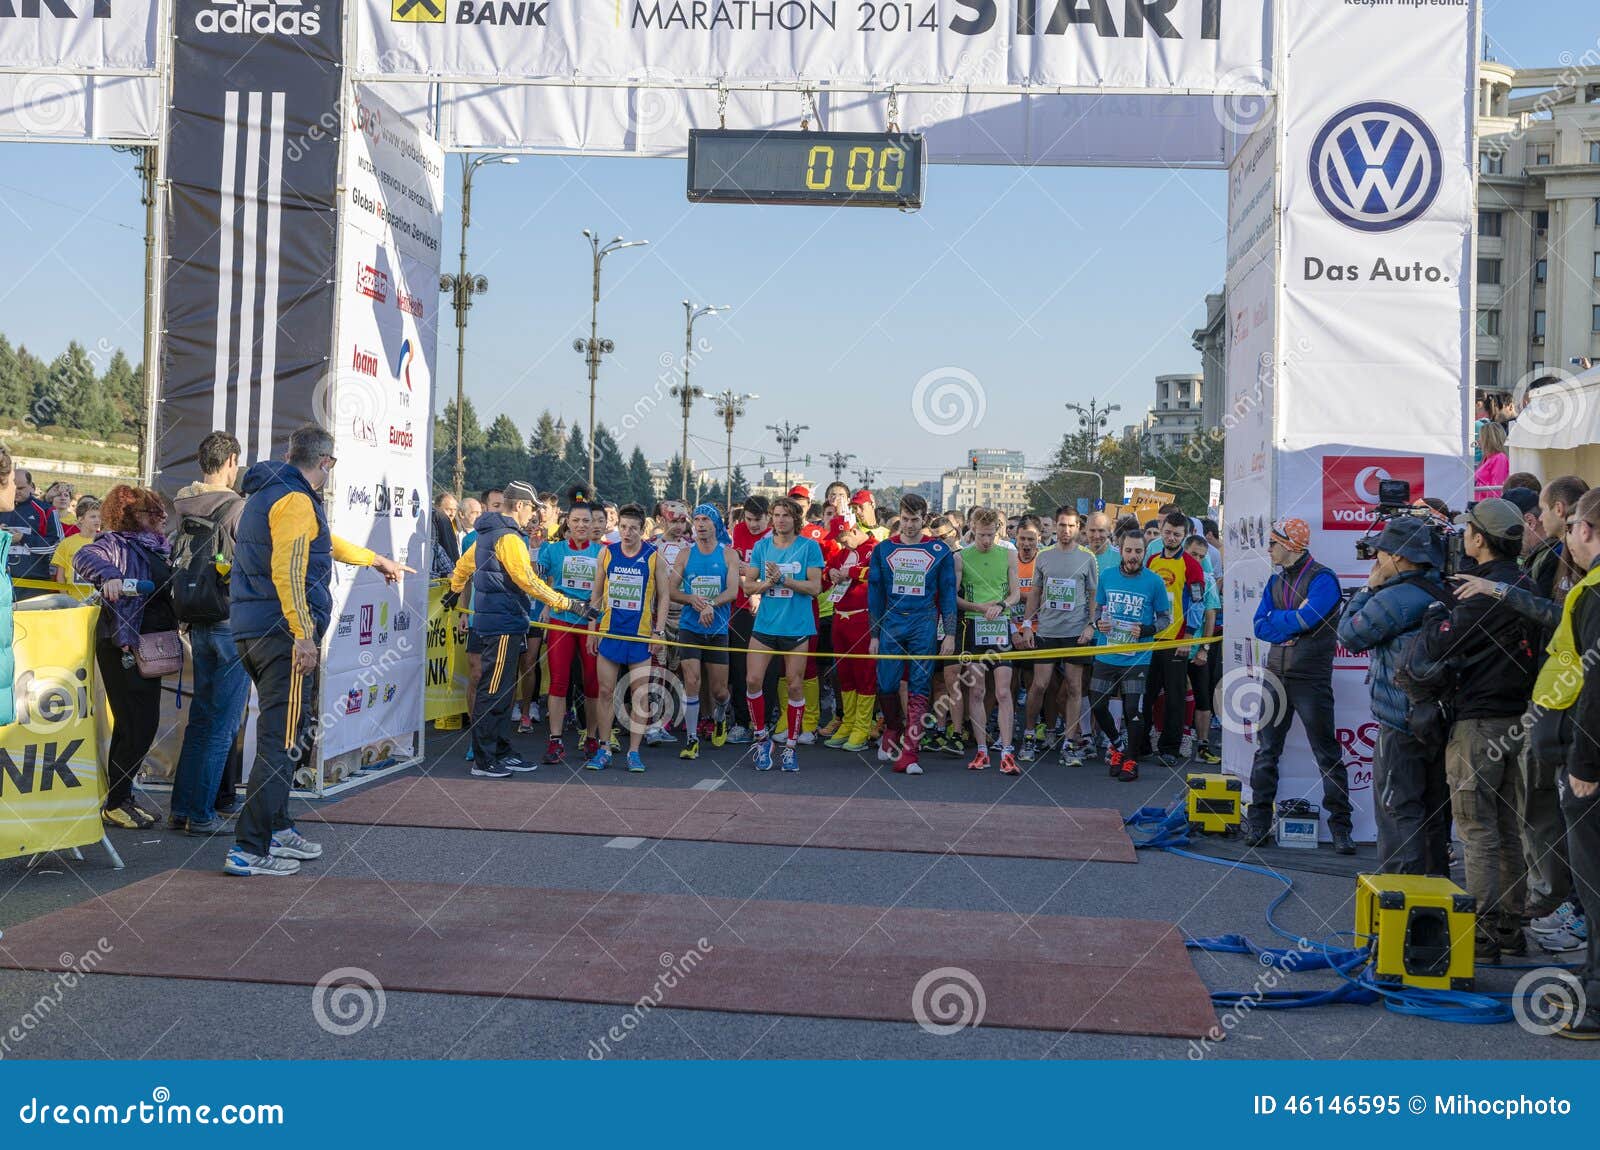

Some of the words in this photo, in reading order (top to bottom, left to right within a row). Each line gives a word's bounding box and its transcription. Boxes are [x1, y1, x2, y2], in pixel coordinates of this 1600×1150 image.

[195, 3, 320, 35] adidas
[455, 0, 549, 26] BANK
[631, 0, 837, 31] MARATHON
[857, 2, 939, 32] 2014
[352, 187, 375, 215] Global
[376, 201, 411, 235] Relocation
[411, 225, 438, 251] Services
[1304, 257, 1360, 282] Das
[1369, 257, 1452, 283] Auto.
[352, 343, 378, 378] Ioana
[389, 425, 414, 451] Europa
[613, 565, 642, 576] ROMANIA
[1108, 592, 1145, 606] TEAM
